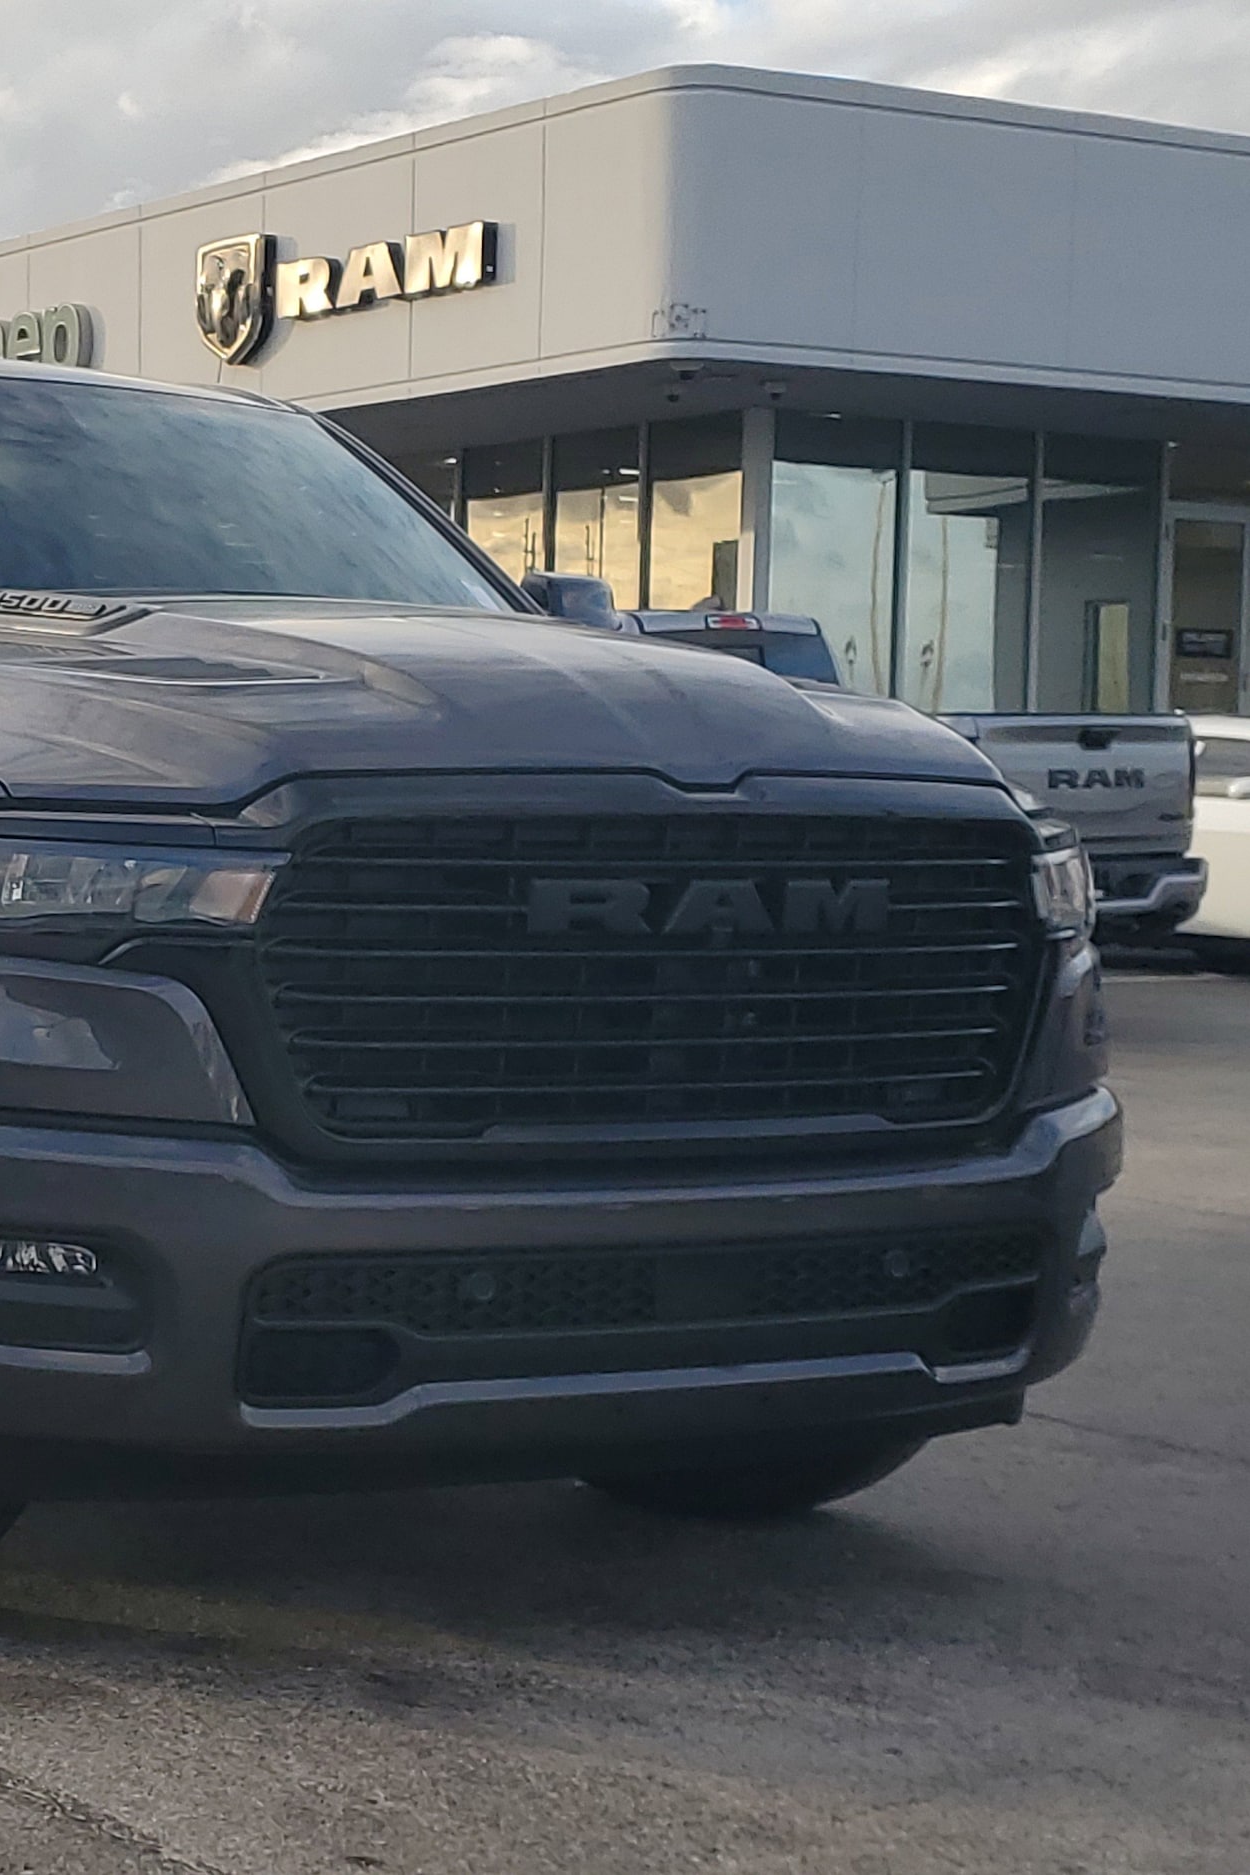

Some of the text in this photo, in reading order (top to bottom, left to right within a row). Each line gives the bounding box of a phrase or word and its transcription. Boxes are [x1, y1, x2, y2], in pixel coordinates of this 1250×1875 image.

[276, 220, 490, 319] RAM
[1048, 768, 1145, 789] RAM
[527, 878, 890, 934] RAM
